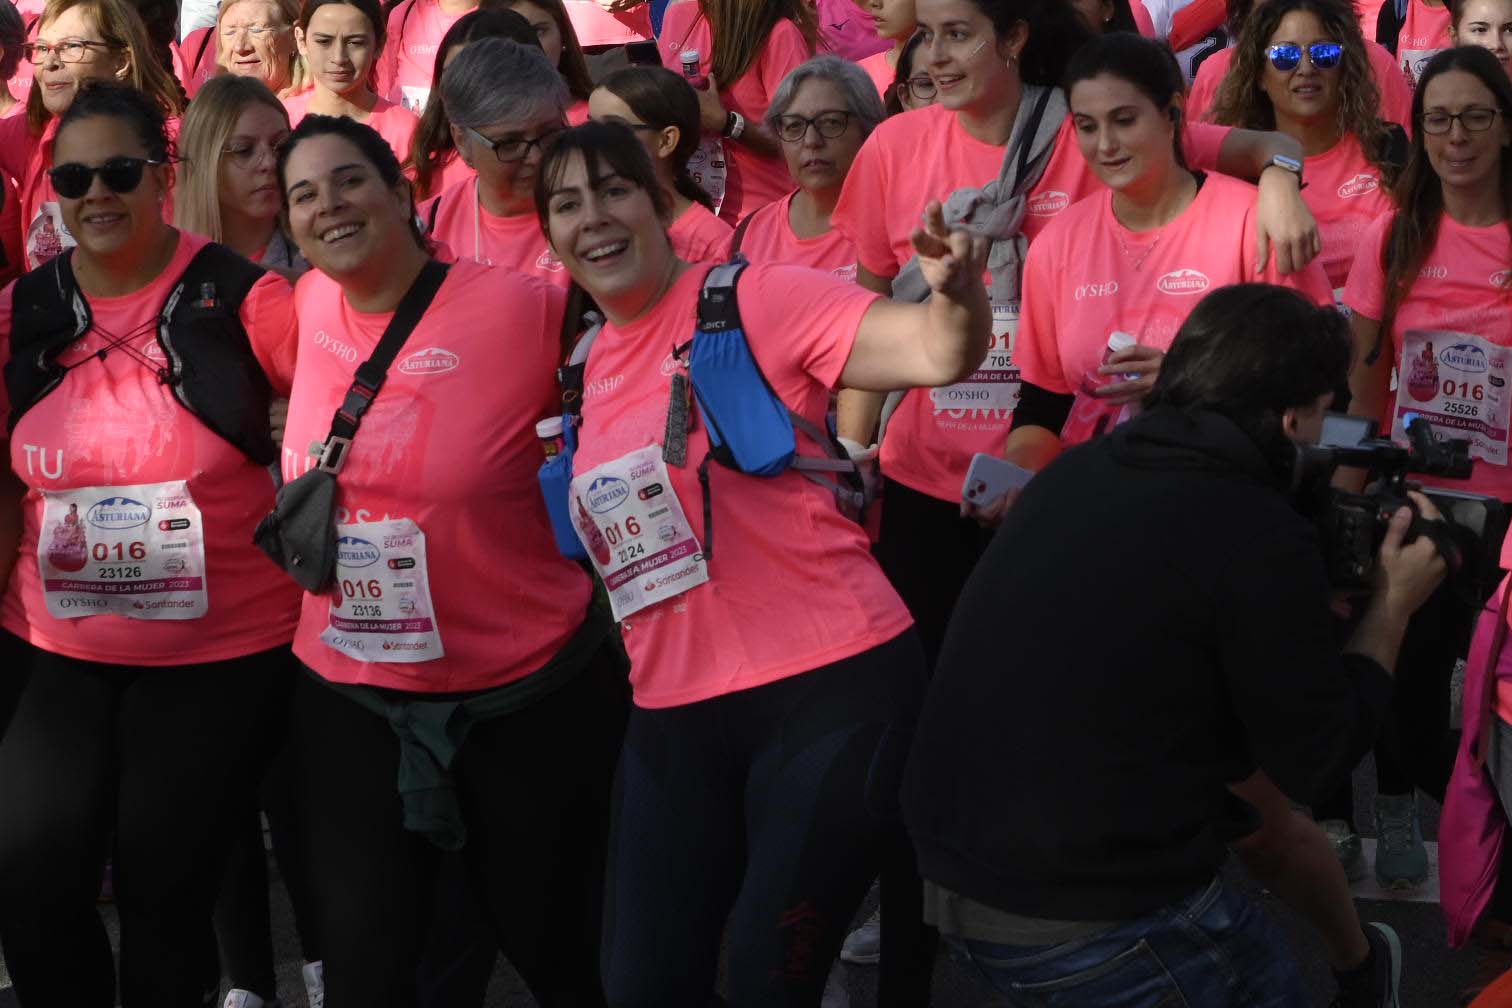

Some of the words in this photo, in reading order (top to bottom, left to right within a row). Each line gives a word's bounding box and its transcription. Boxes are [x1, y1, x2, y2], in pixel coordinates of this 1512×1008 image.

[1075, 281, 1118, 301] OYSHO
[1161, 278, 1205, 290] ASTURIANA
[313, 330, 357, 363] OYSHO
[402, 359, 455, 370] ASTURIANA
[949, 391, 989, 401] OYSHO
[1443, 379, 1484, 401] 016
[1443, 401, 1478, 417] 25526
[23, 444, 63, 479] TU
[631, 465, 656, 481] SUMA
[156, 499, 188, 510] SUMA
[91, 510, 149, 522] ASTURIANA
[605, 516, 641, 545] 016
[92, 541, 146, 561] 016
[384, 539, 413, 549] SUMA
[641, 554, 668, 572] MUJER
[99, 566, 142, 579] 23126
[656, 564, 700, 587] Santander
[62, 582, 102, 592] CARRERA
[104, 583, 118, 592] DE
[120, 583, 132, 592] LA
[134, 582, 165, 592] MUJER
[169, 580, 190, 589] 2023
[342, 579, 382, 598] 016
[60, 597, 108, 609] OYSHO
[145, 599, 194, 610] Santander
[352, 604, 382, 617] 23136
[390, 641, 428, 650] Santander
